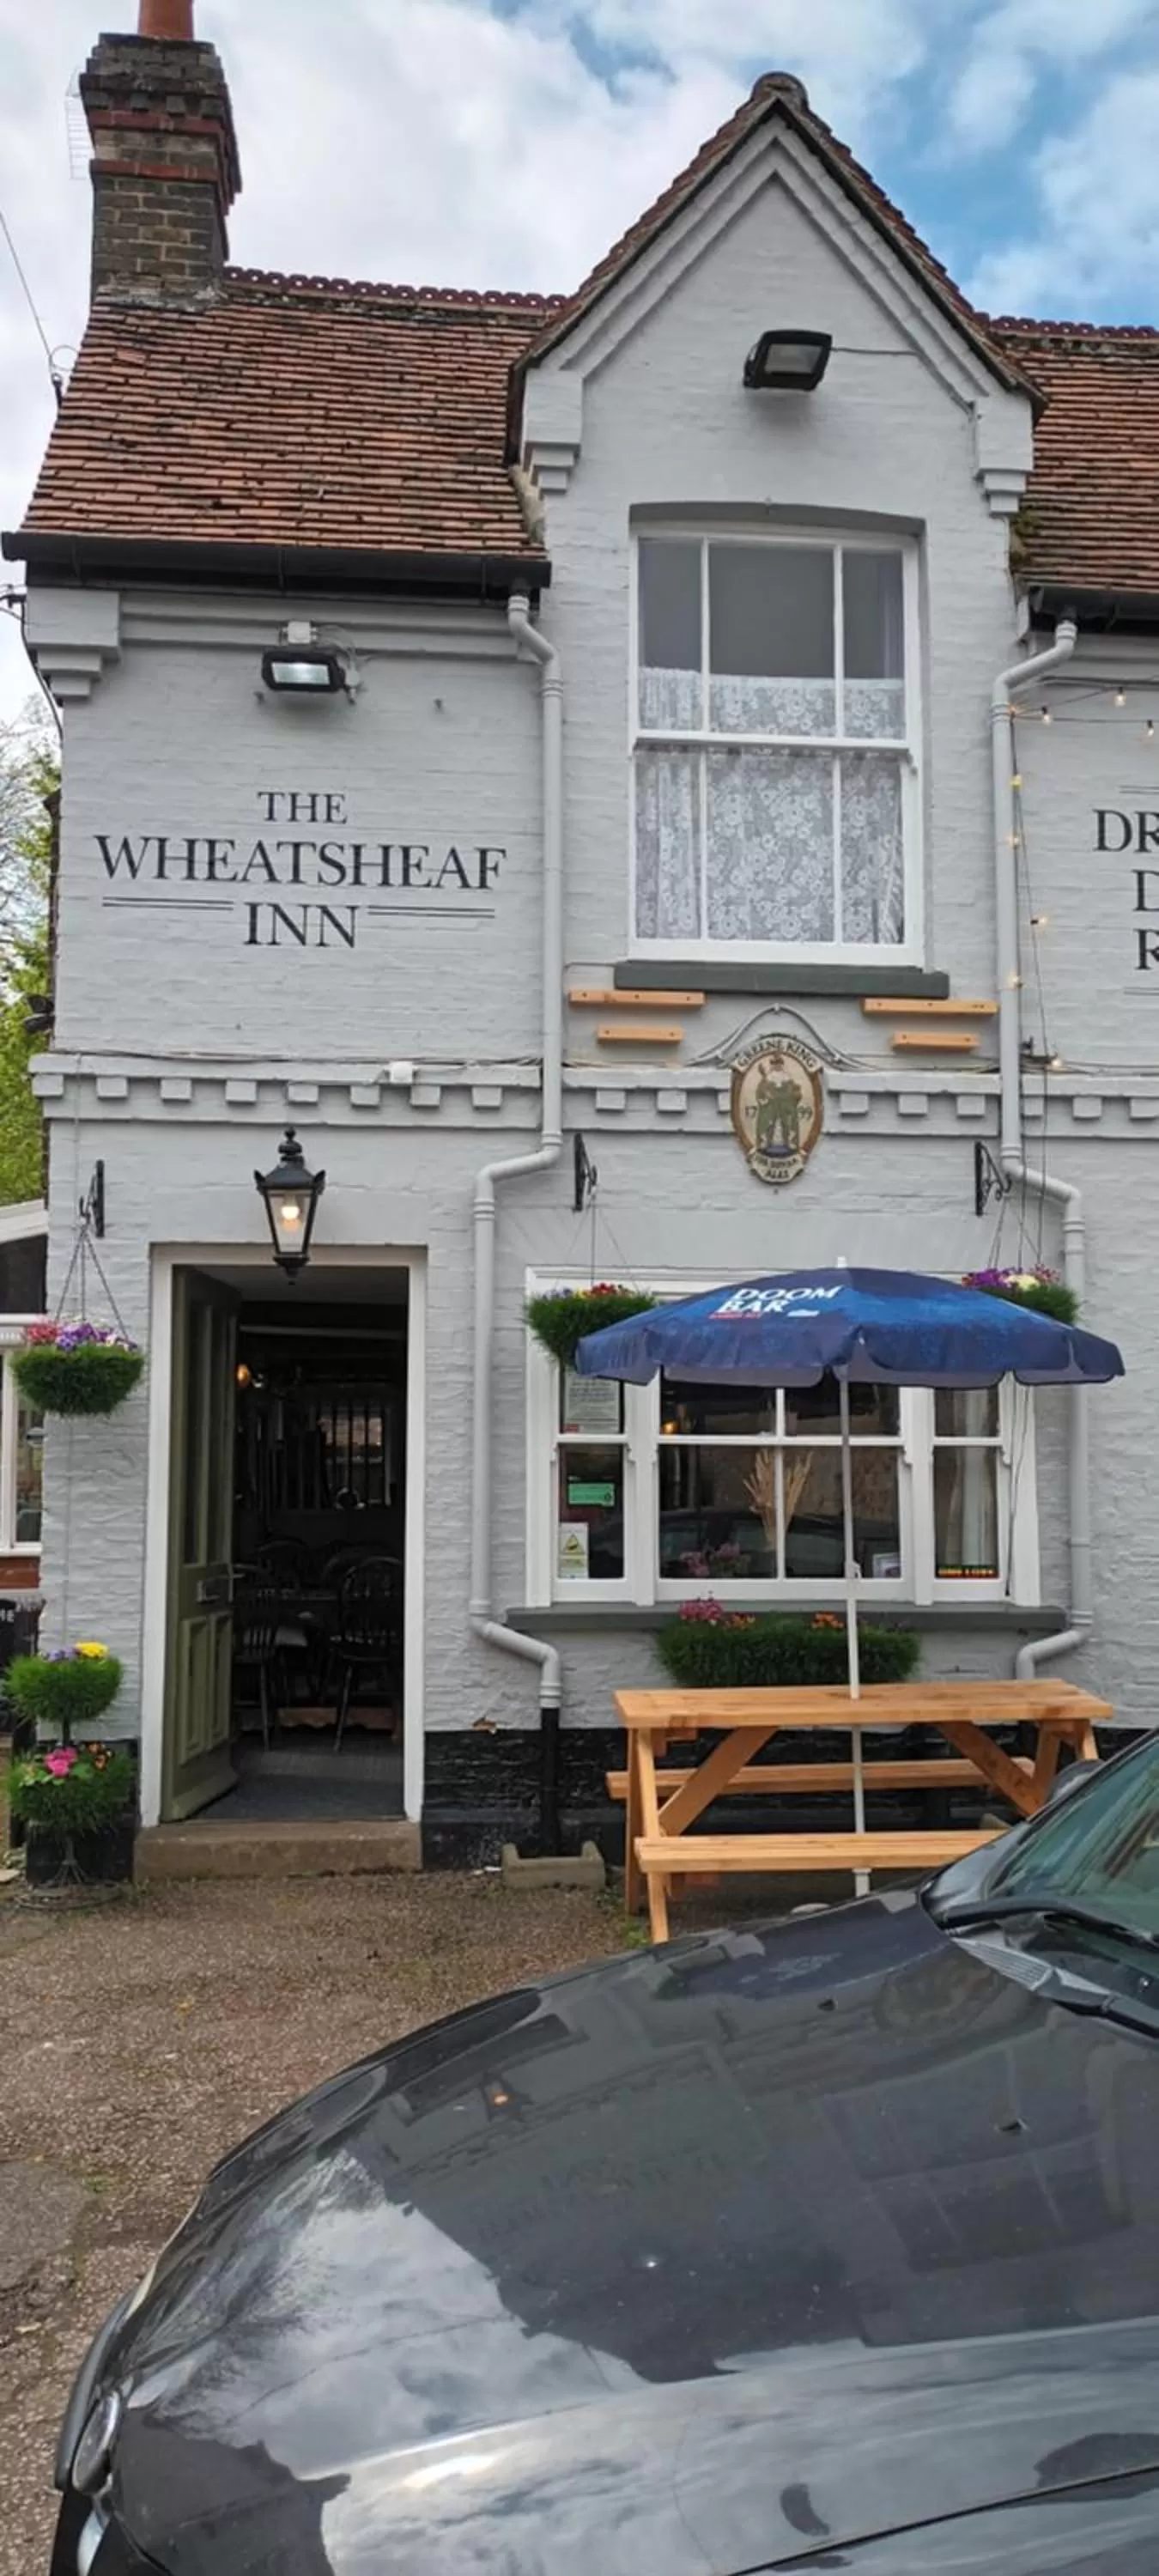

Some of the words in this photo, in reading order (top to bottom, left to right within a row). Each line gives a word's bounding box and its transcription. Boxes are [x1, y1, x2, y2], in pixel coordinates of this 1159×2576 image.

[258, 791, 348, 824] THE
[93, 834, 507, 890] WHEATSHEAF
[243, 901, 361, 949] INN
[786, 1040, 818, 1068] KING
[715, 1299, 790, 1313] BAR
[731, 1285, 844, 1301] DOOM
